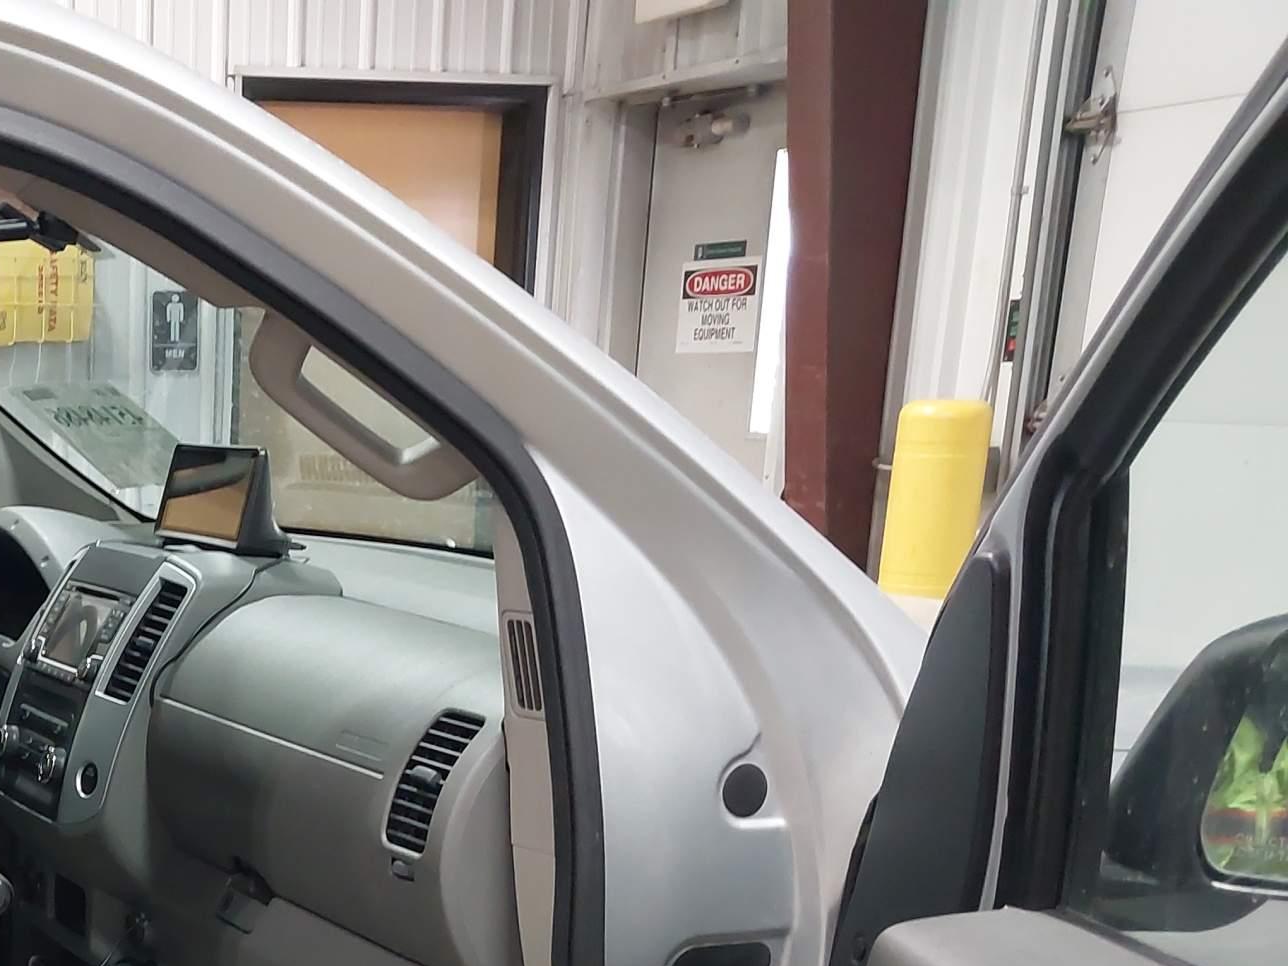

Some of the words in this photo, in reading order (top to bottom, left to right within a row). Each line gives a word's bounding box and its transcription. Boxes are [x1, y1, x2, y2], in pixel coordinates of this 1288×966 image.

[694, 273, 746, 292] DANGER
[688, 301, 713, 312] WATCH
[715, 299, 731, 311] OUT
[732, 298, 747, 310] FOR
[701, 313, 730, 326] MOVING
[693, 327, 736, 341] EQUIPMENT
[165, 348, 185, 358] MEN
